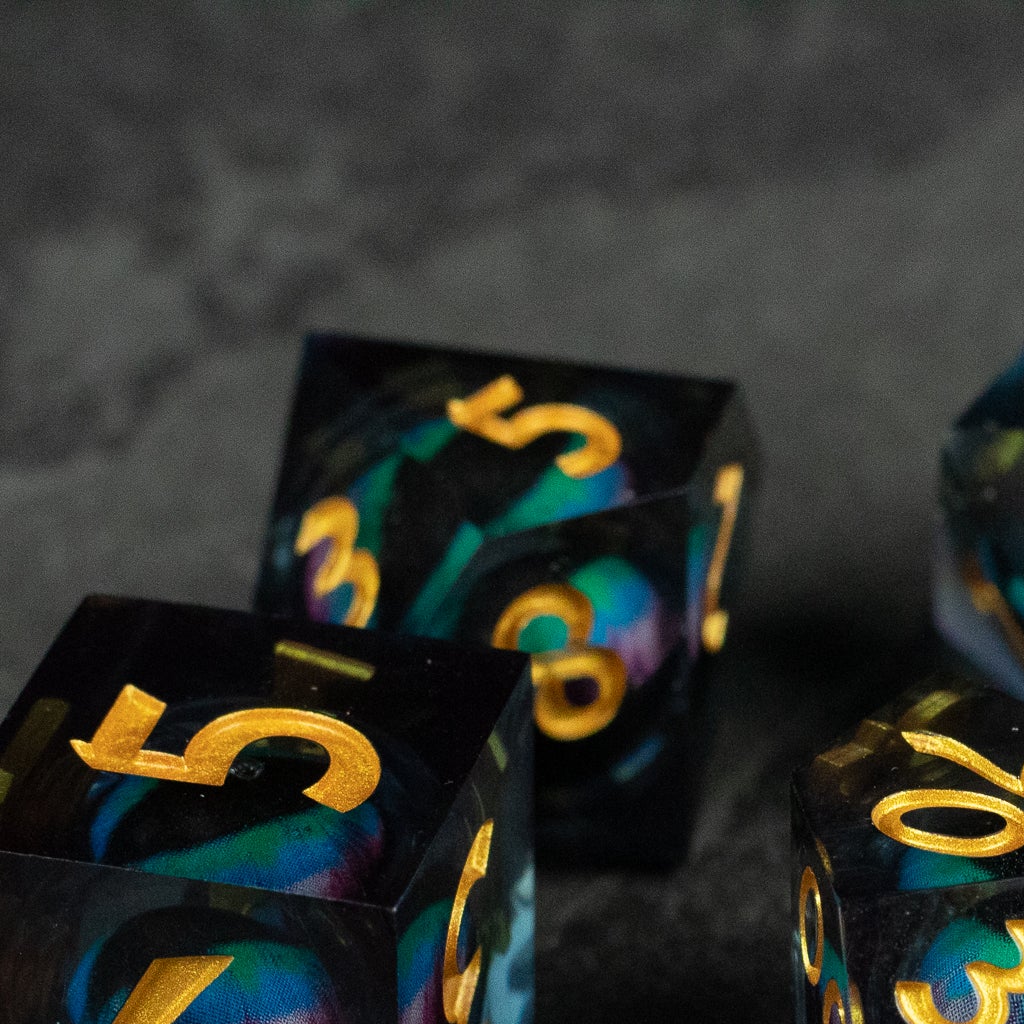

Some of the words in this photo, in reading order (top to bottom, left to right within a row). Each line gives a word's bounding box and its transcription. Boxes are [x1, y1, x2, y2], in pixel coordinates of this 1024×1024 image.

[446, 375, 621, 478] 5
[296, 496, 380, 629] 3
[70, 684, 381, 813] 5
